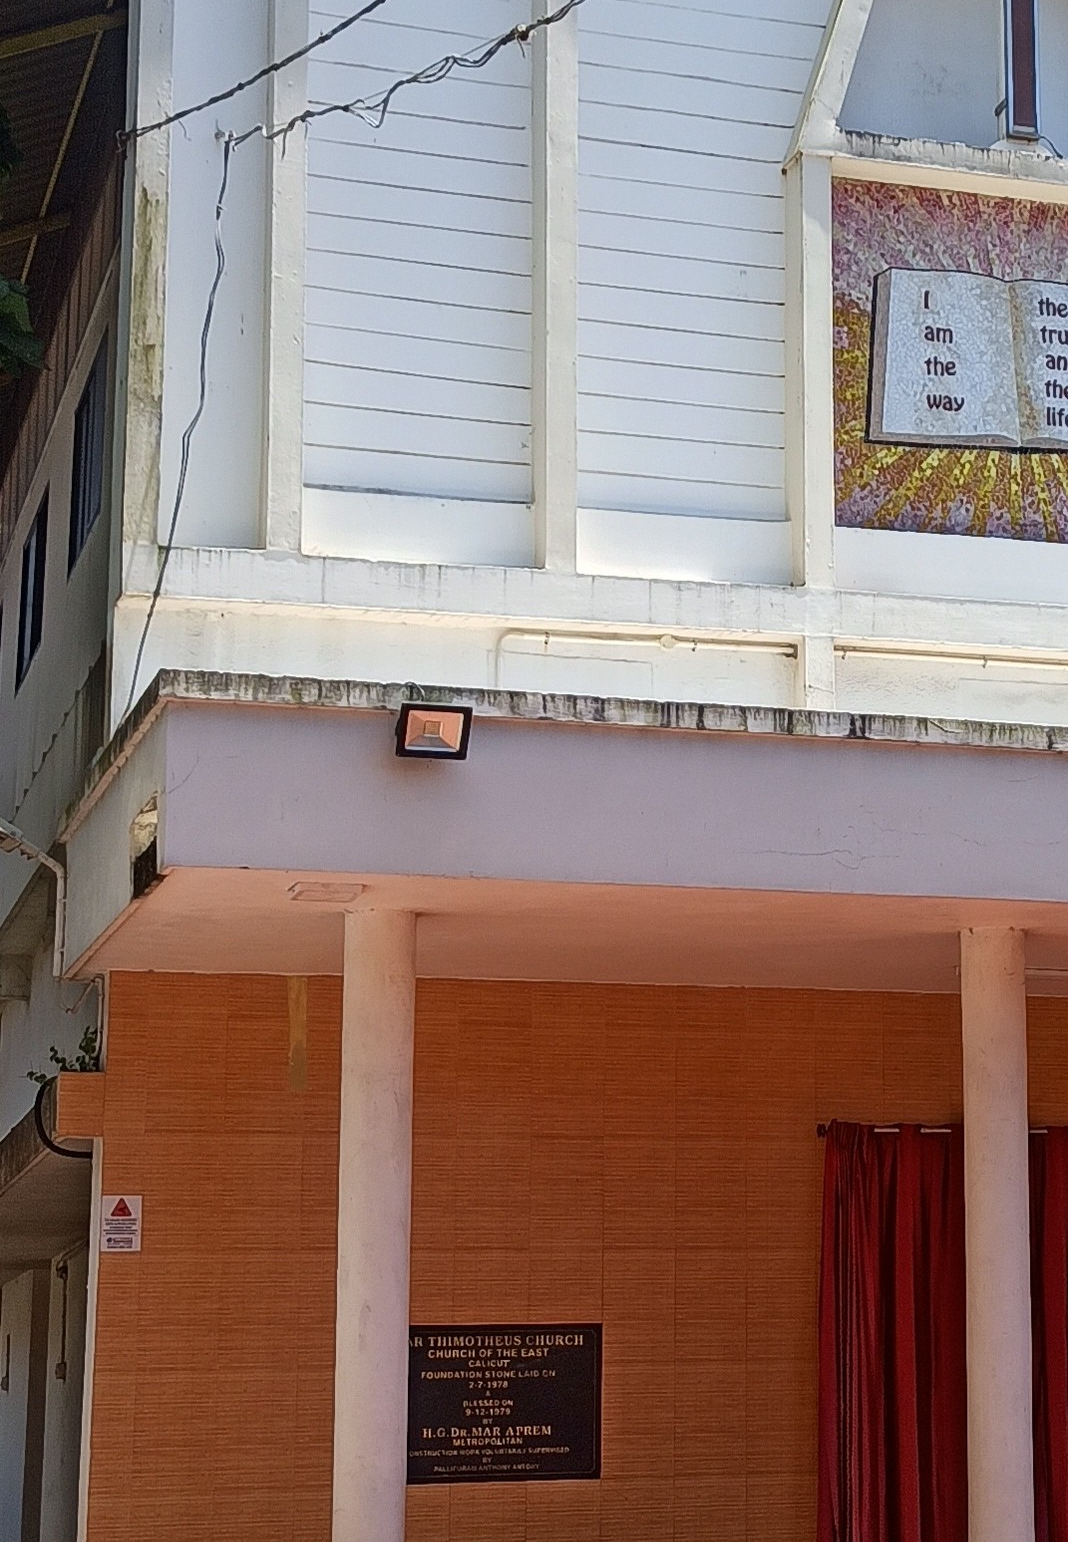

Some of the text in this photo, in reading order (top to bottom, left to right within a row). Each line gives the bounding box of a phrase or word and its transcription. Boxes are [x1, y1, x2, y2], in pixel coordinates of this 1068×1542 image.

[924, 290, 930, 309] I
[1038, 297, 1068, 318] the
[924, 325, 953, 344] am
[924, 356, 957, 376] the
[926, 393, 965, 412] way
[428, 1335, 522, 1347] THIMOTHEUS
[526, 1334, 584, 1346] CHURCH
[428, 1348, 549, 1358] CHURCH OF THE EAST
[468, 1359, 511, 1367] CALICUT
[421, 1369, 556, 1379] FOUNDATION STONE LAID ON
[505, 1425, 552, 1436] APREM
[453, 1437, 523, 1446] METROPOLITAN
[409, 1449, 457, 1457] ONSTRUCTION
